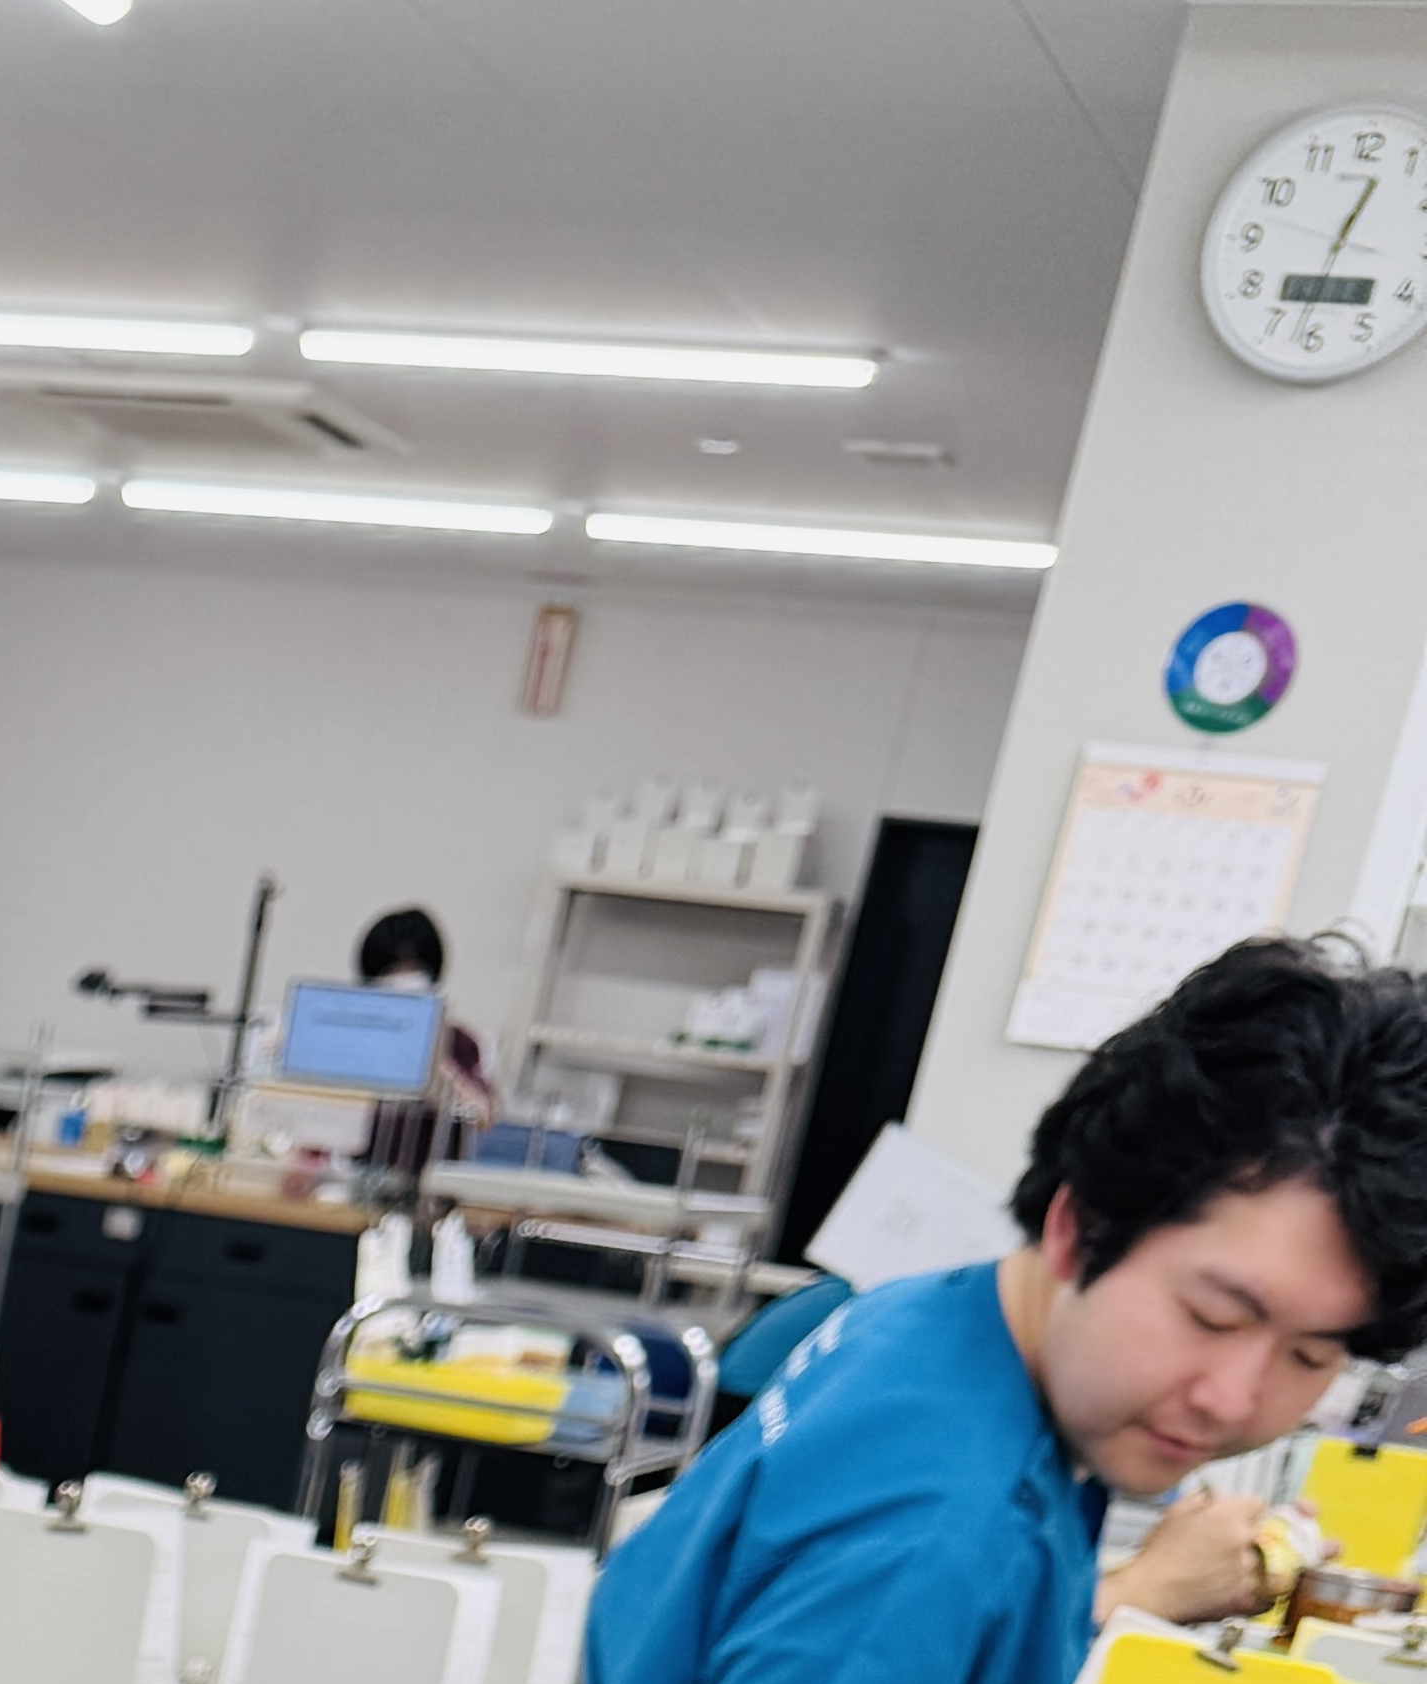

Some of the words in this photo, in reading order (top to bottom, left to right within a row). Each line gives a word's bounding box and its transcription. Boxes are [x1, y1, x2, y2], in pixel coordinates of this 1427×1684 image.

[1306, 143, 1335, 174] 11
[1353, 132, 1386, 162] 12
[1404, 146, 1420, 178] 1
[1261, 176, 1297, 207] 10
[1239, 221, 1265, 253] 9
[1238, 268, 1265, 299] 8
[1264, 306, 1288, 337] 7
[1350, 312, 1377, 343] 5
[1299, 322, 1325, 353] 6
